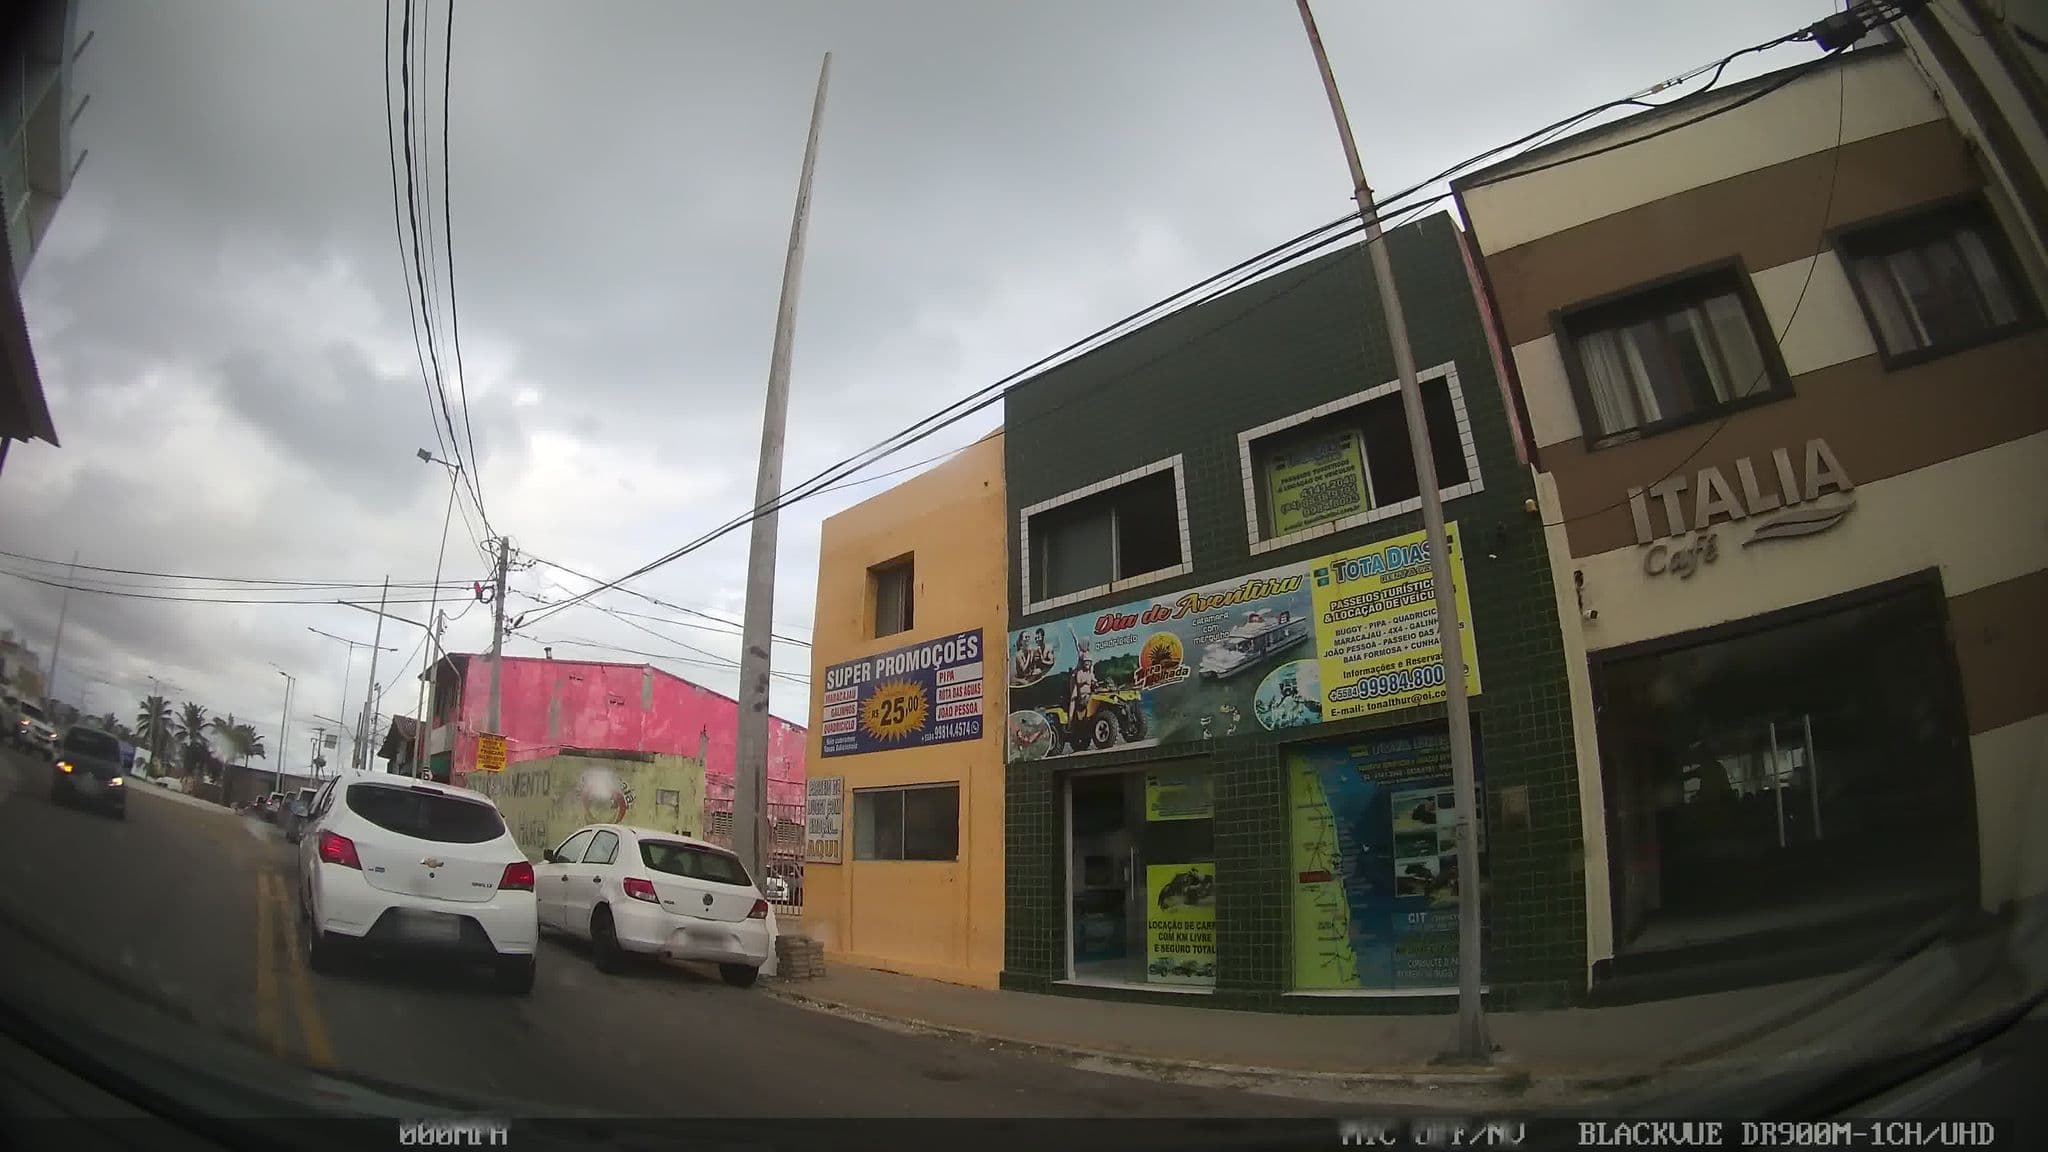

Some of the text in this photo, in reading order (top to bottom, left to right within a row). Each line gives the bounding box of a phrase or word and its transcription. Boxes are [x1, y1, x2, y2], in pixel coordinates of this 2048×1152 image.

[1628, 438, 1854, 545] ITALIA
[1332, 541, 1432, 583] TOTA DIAS
[1417, 564, 1432, 574] CA
[1644, 533, 1720, 581] Café
[1094, 574, 1304, 635] Dia de Aventura
[1324, 613, 1333, 624] &
[1386, 599, 1400, 611] DE
[1402, 589, 1436, 608] VEÍCU
[1331, 578, 1435, 611] PASSEIOS TURÍSTIC
[1334, 630, 1382, 646] MARACAJAU
[1388, 625, 1403, 636] 4X4
[1410, 618, 1439, 632] GALINH
[1335, 625, 1362, 637] BUGGY
[1369, 619, 1387, 630] PIPA
[1393, 608, 1438, 623] QUADRICIC
[1324, 646, 1345, 658] JOÃO
[1346, 641, 1377, 654] PESSOA
[1383, 634, 1417, 650] PASSEIO
[1418, 628, 1435, 638] DAS
[1364, 645, 1402, 660] FORMOSA
[1411, 638, 1440, 650] CUNHA
[827, 662, 871, 690] SUPER
[939, 670, 955, 683] PIPA
[1343, 661, 1396, 680] Informações
[1358, 664, 1446, 699] 99984.800
[953, 686, 963, 698] DAS
[1331, 689, 1447, 717] E-mail: tonalthur@oi.co
[880, 694, 919, 727] 25,00
[954, 701, 978, 717] PESSOA
[807, 839, 839, 860] AQUI
[1148, 920, 1183, 931] LOCAÇÃO
[1185, 921, 1194, 930] DE
[1158, 932, 1175, 942] COM
[1189, 933, 1212, 943] LIVRE
[1154, 943, 1217, 955] E SEGURO TOTAL
